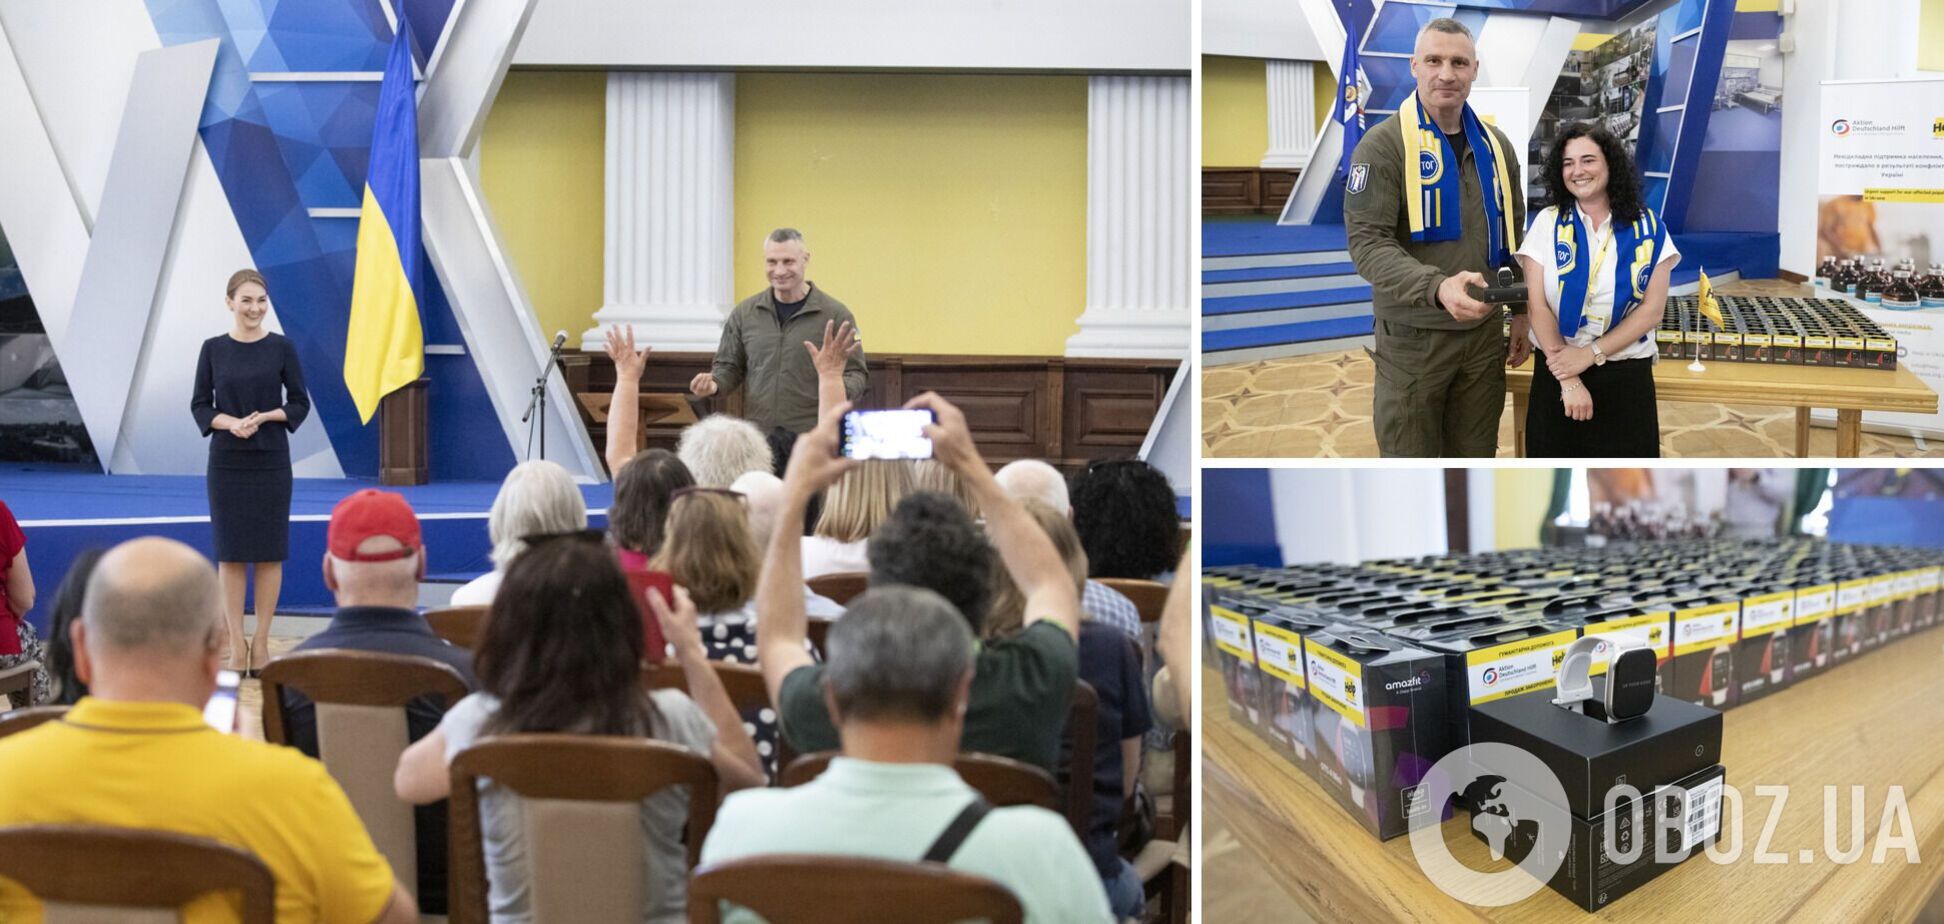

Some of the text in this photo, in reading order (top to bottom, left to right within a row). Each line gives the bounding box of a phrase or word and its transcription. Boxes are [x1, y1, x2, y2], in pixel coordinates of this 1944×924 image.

[1420, 160, 1435, 171] ТОГ
[1557, 250, 1569, 262] ТОГ
[1640, 274, 1648, 285] УТ
[1499, 640, 1555, 657] ГУМАНІТАРНА ДОПОМОГА
[1552, 651, 1566, 667] Hel
[1499, 667, 1527, 678] Deutschland
[1345, 680, 1356, 696] Help
[1385, 676, 1422, 691] amazfit
[1504, 687, 1525, 697] ПРОДАЖ
